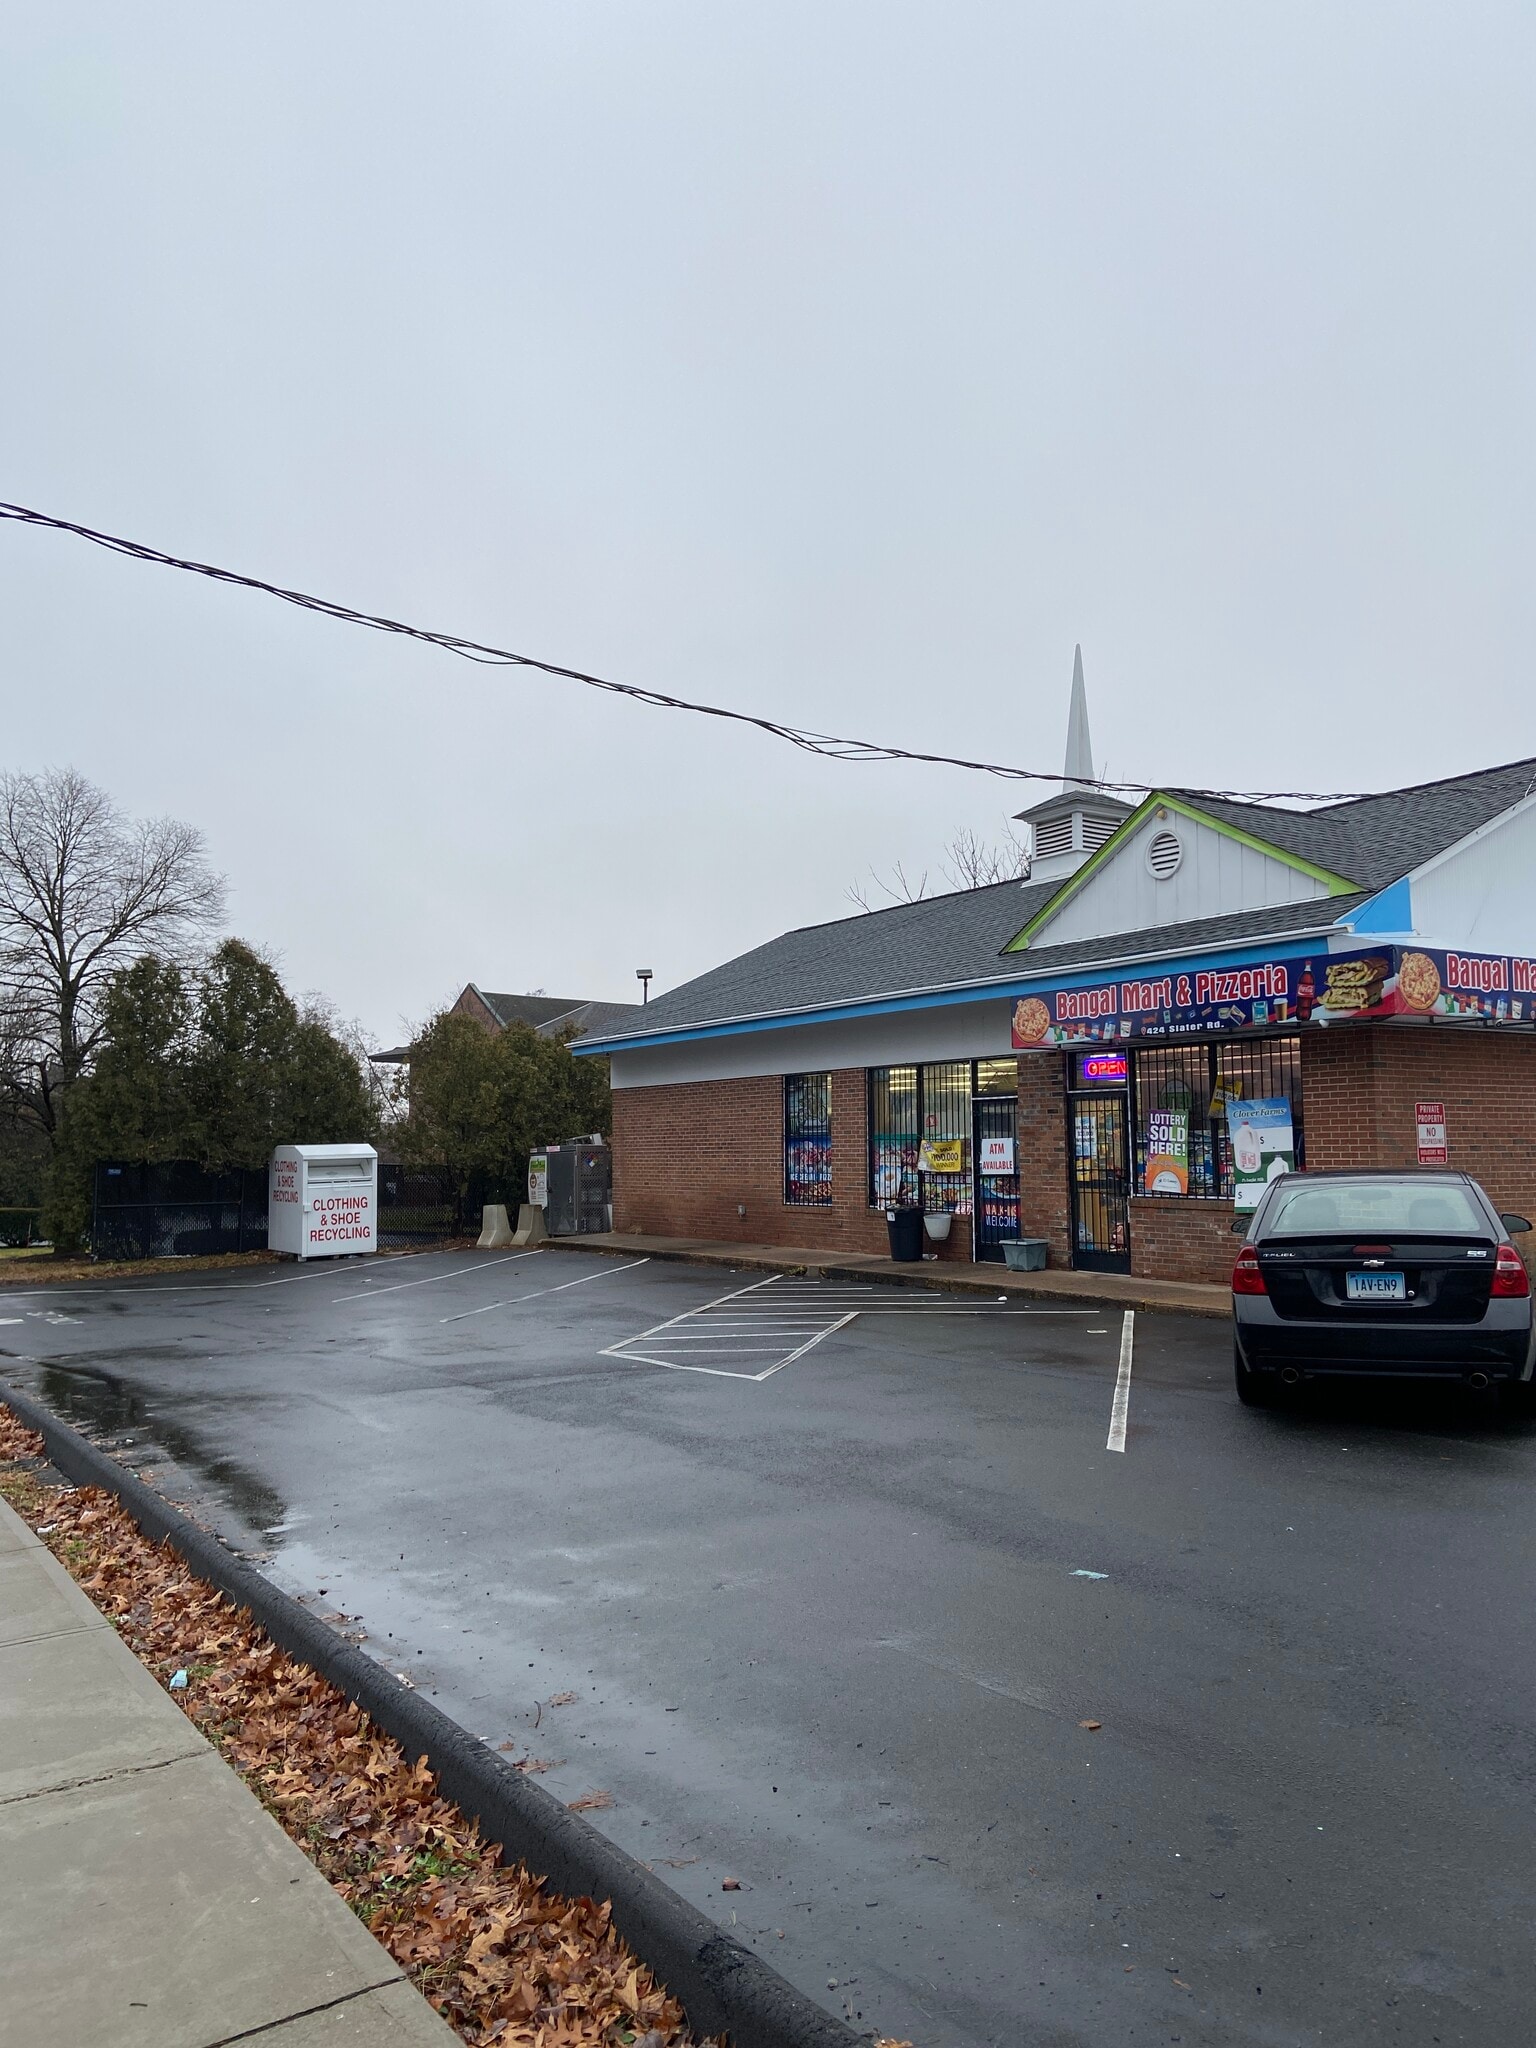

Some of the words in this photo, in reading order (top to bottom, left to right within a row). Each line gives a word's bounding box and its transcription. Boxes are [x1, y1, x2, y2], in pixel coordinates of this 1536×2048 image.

[1446, 953, 1509, 993] Bangal
[1512, 958, 1536, 992] Ma
[1056, 985, 1117, 1021] Bangal
[1121, 978, 1171, 1013] Mart
[1177, 976, 1192, 1006] &
[1196, 964, 1288, 1004] Pizzeria
[1146, 1026, 1165, 1035] 424
[1169, 1023, 1203, 1033] Slater
[1206, 1021, 1225, 1029] Rd.
[1087, 1060, 1126, 1076] OPEN
[1232, 1108, 1260, 1119] Clover
[1260, 1107, 1286, 1117] Farms
[1420, 1105, 1440, 1114] PRIVATE
[1150, 1113, 1186, 1126] LOTTERY
[1418, 1114, 1443, 1123] PROPERTY
[1150, 1125, 1186, 1142] SOLD
[1426, 1127, 1436, 1137] NO
[989, 1143, 1005, 1155] ATM
[1150, 1141, 1186, 1156] HERE!
[275, 1161, 297, 1173] CLOTHING
[983, 1160, 1013, 1170] AVAILABLE
[281, 1175, 294, 1188] SHOE
[273, 1190, 298, 1203] RECYCLING
[313, 1197, 368, 1211] CLOTHING
[320, 1214, 328, 1226] &
[330, 1212, 361, 1225] SHOE
[310, 1226, 371, 1242] RECYCLING
